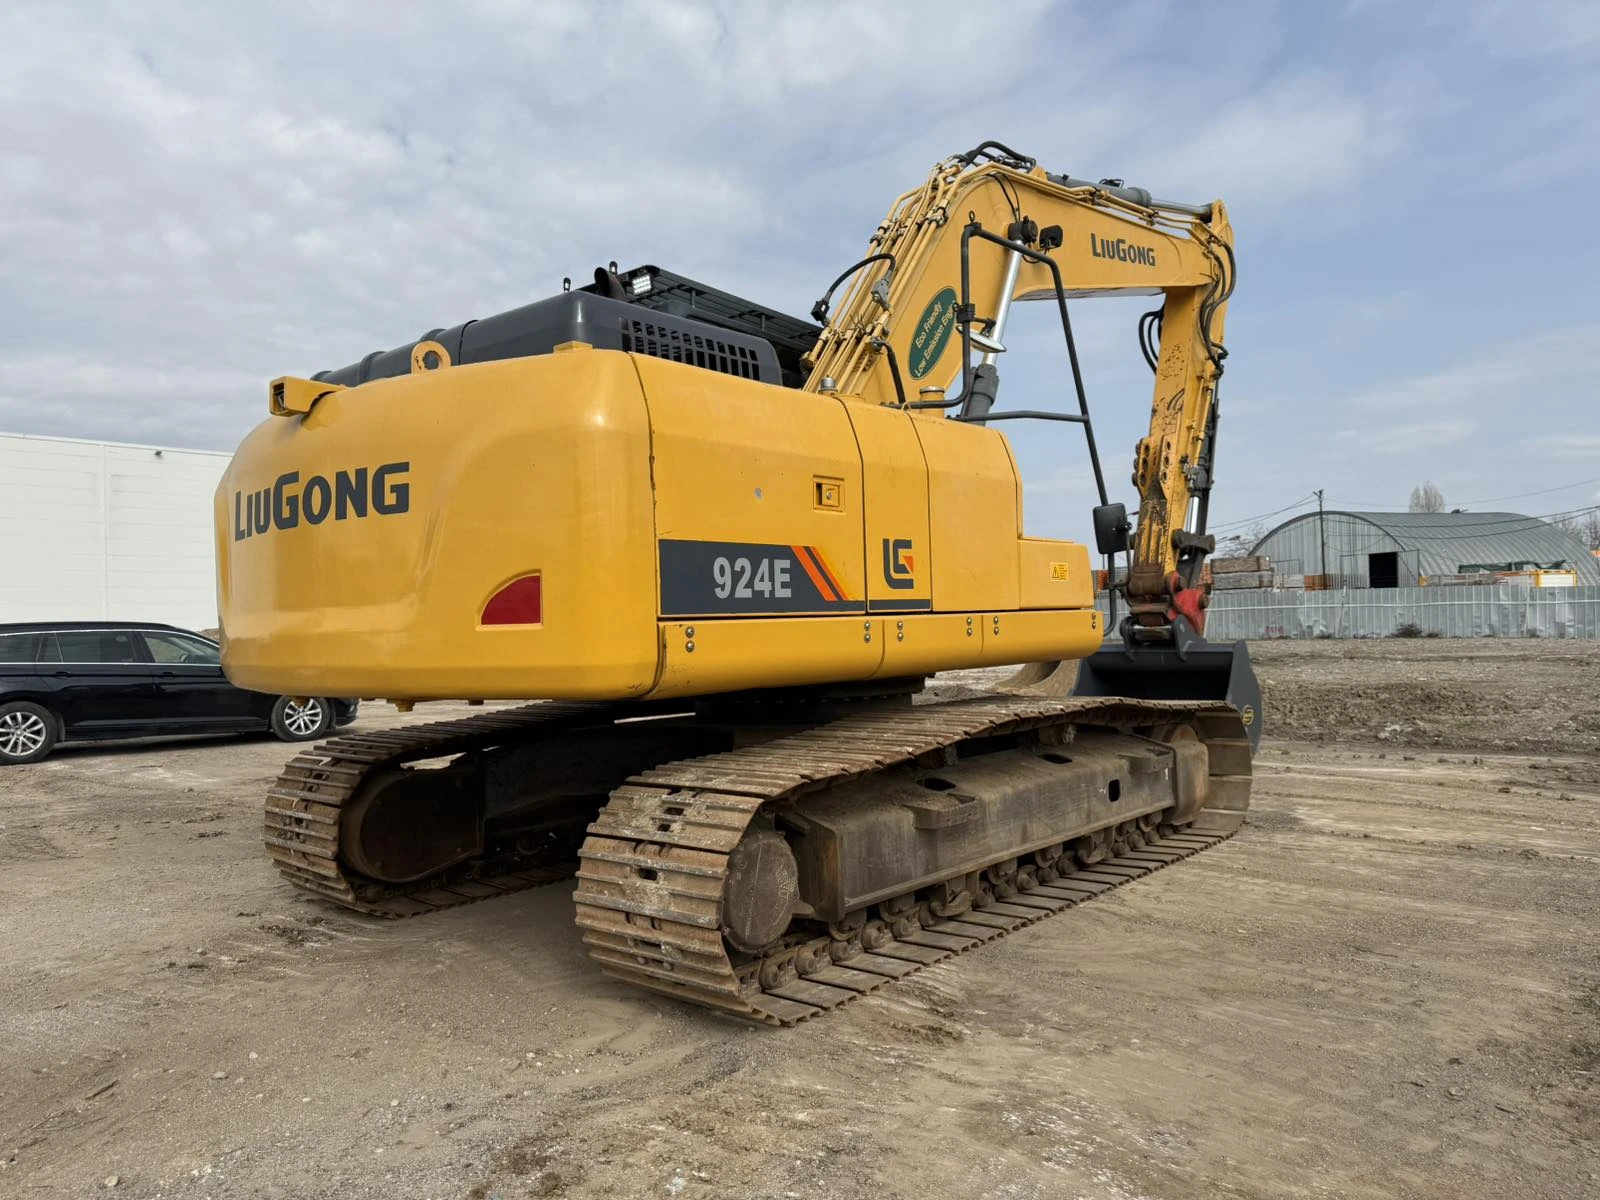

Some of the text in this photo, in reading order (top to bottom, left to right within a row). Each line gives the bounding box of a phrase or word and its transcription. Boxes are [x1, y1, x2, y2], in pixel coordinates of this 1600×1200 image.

[915, 301, 942, 349] Eco Friendly
[914, 359, 927, 377] Low
[924, 325, 944, 359] Emission
[713, 557, 792, 599] 924E
